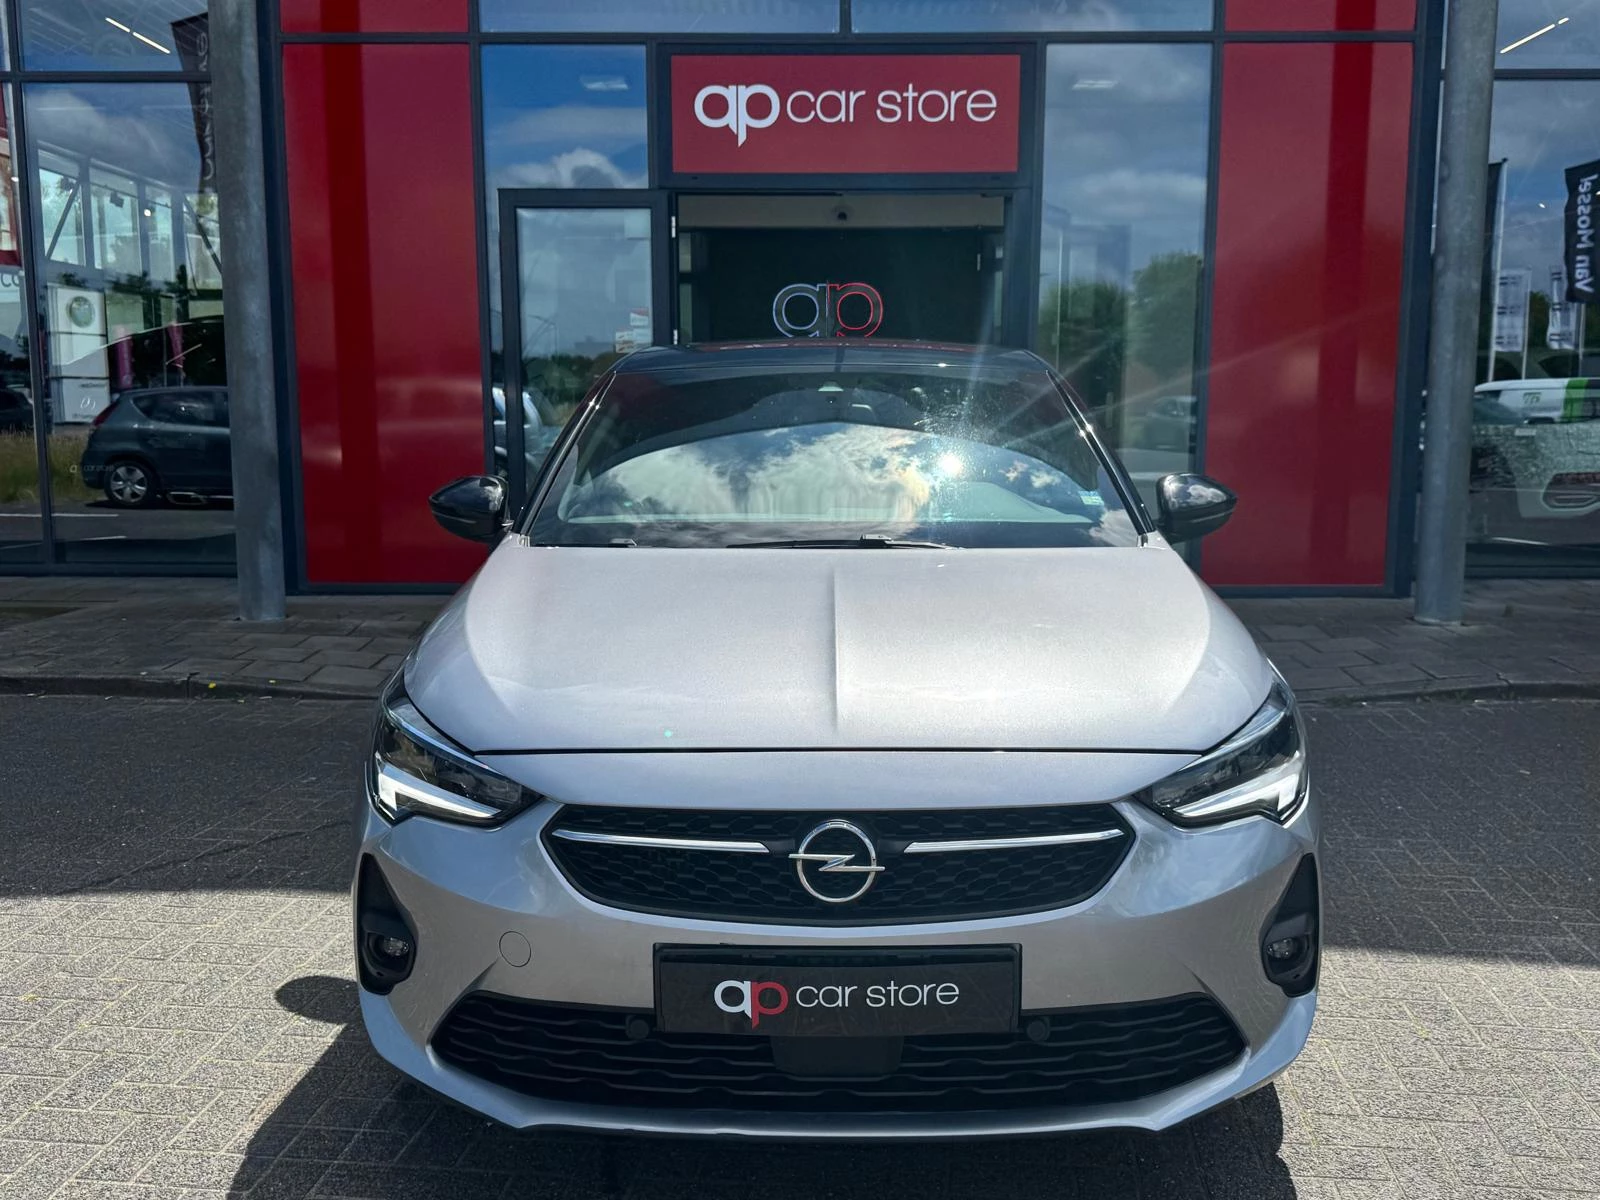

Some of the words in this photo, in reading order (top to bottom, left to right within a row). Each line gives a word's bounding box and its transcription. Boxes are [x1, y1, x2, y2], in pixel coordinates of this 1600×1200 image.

[787, 88, 866, 124] car
[876, 83, 998, 124] store
[795, 984, 857, 1009] car
[866, 980, 960, 1008] store
